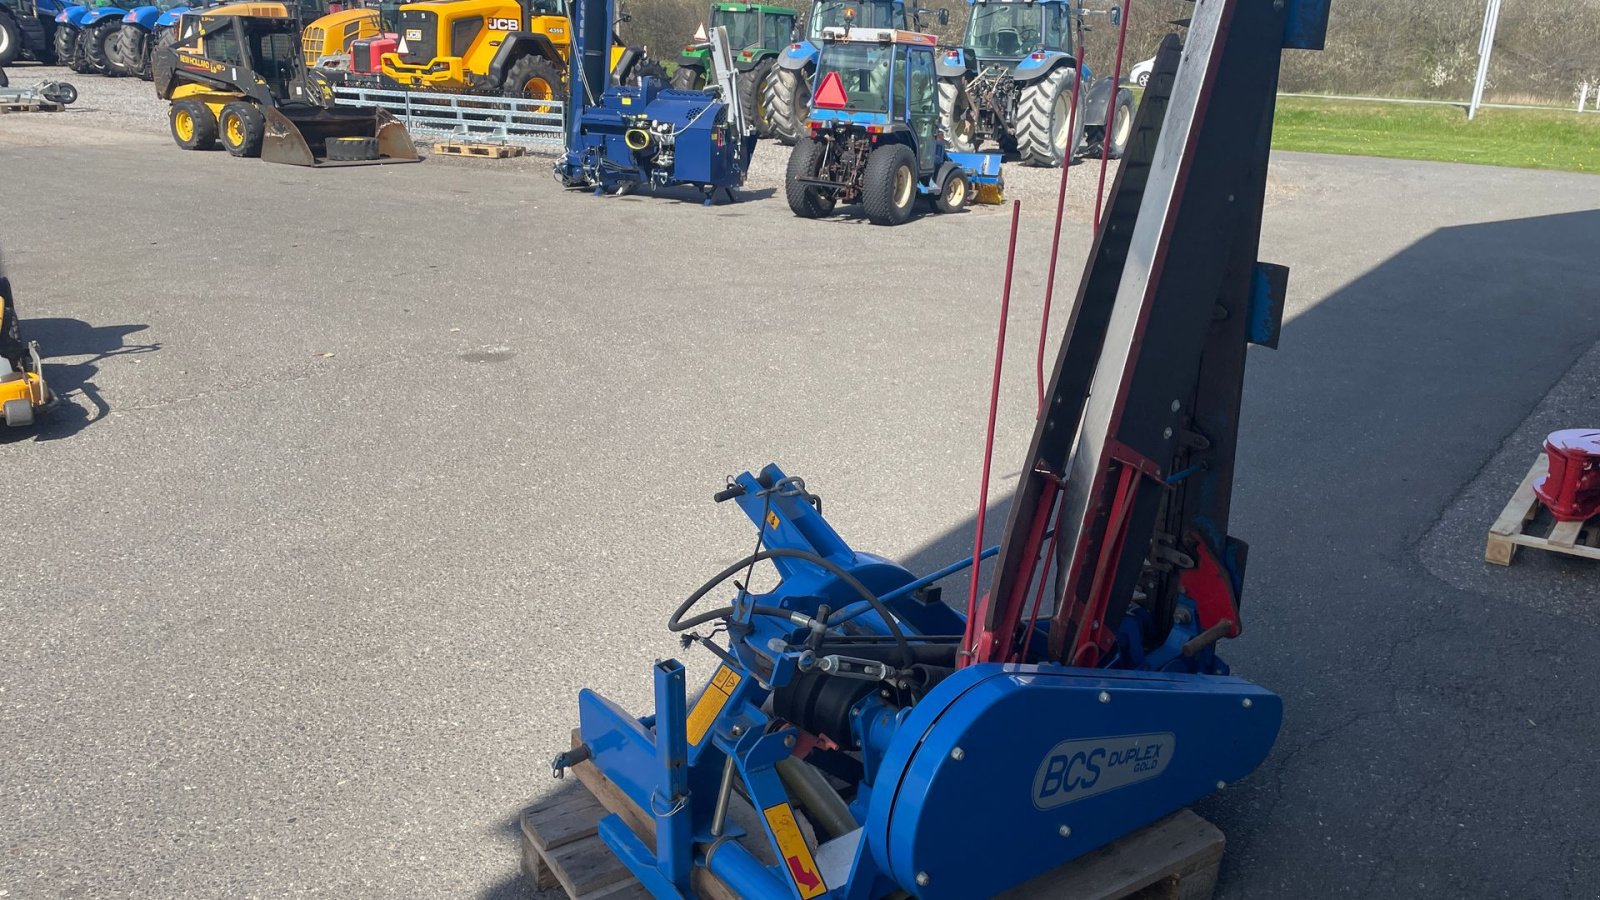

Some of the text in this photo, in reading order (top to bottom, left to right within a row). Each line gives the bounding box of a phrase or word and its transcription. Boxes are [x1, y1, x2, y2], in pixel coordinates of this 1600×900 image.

[488, 18, 519, 31] JCB
[180, 54, 190, 64] NEW
[190, 57, 210, 69] HOLLAND
[1039, 744, 1163, 798] BCS DUPLEX
[1133, 759, 1158, 773] GOLD
